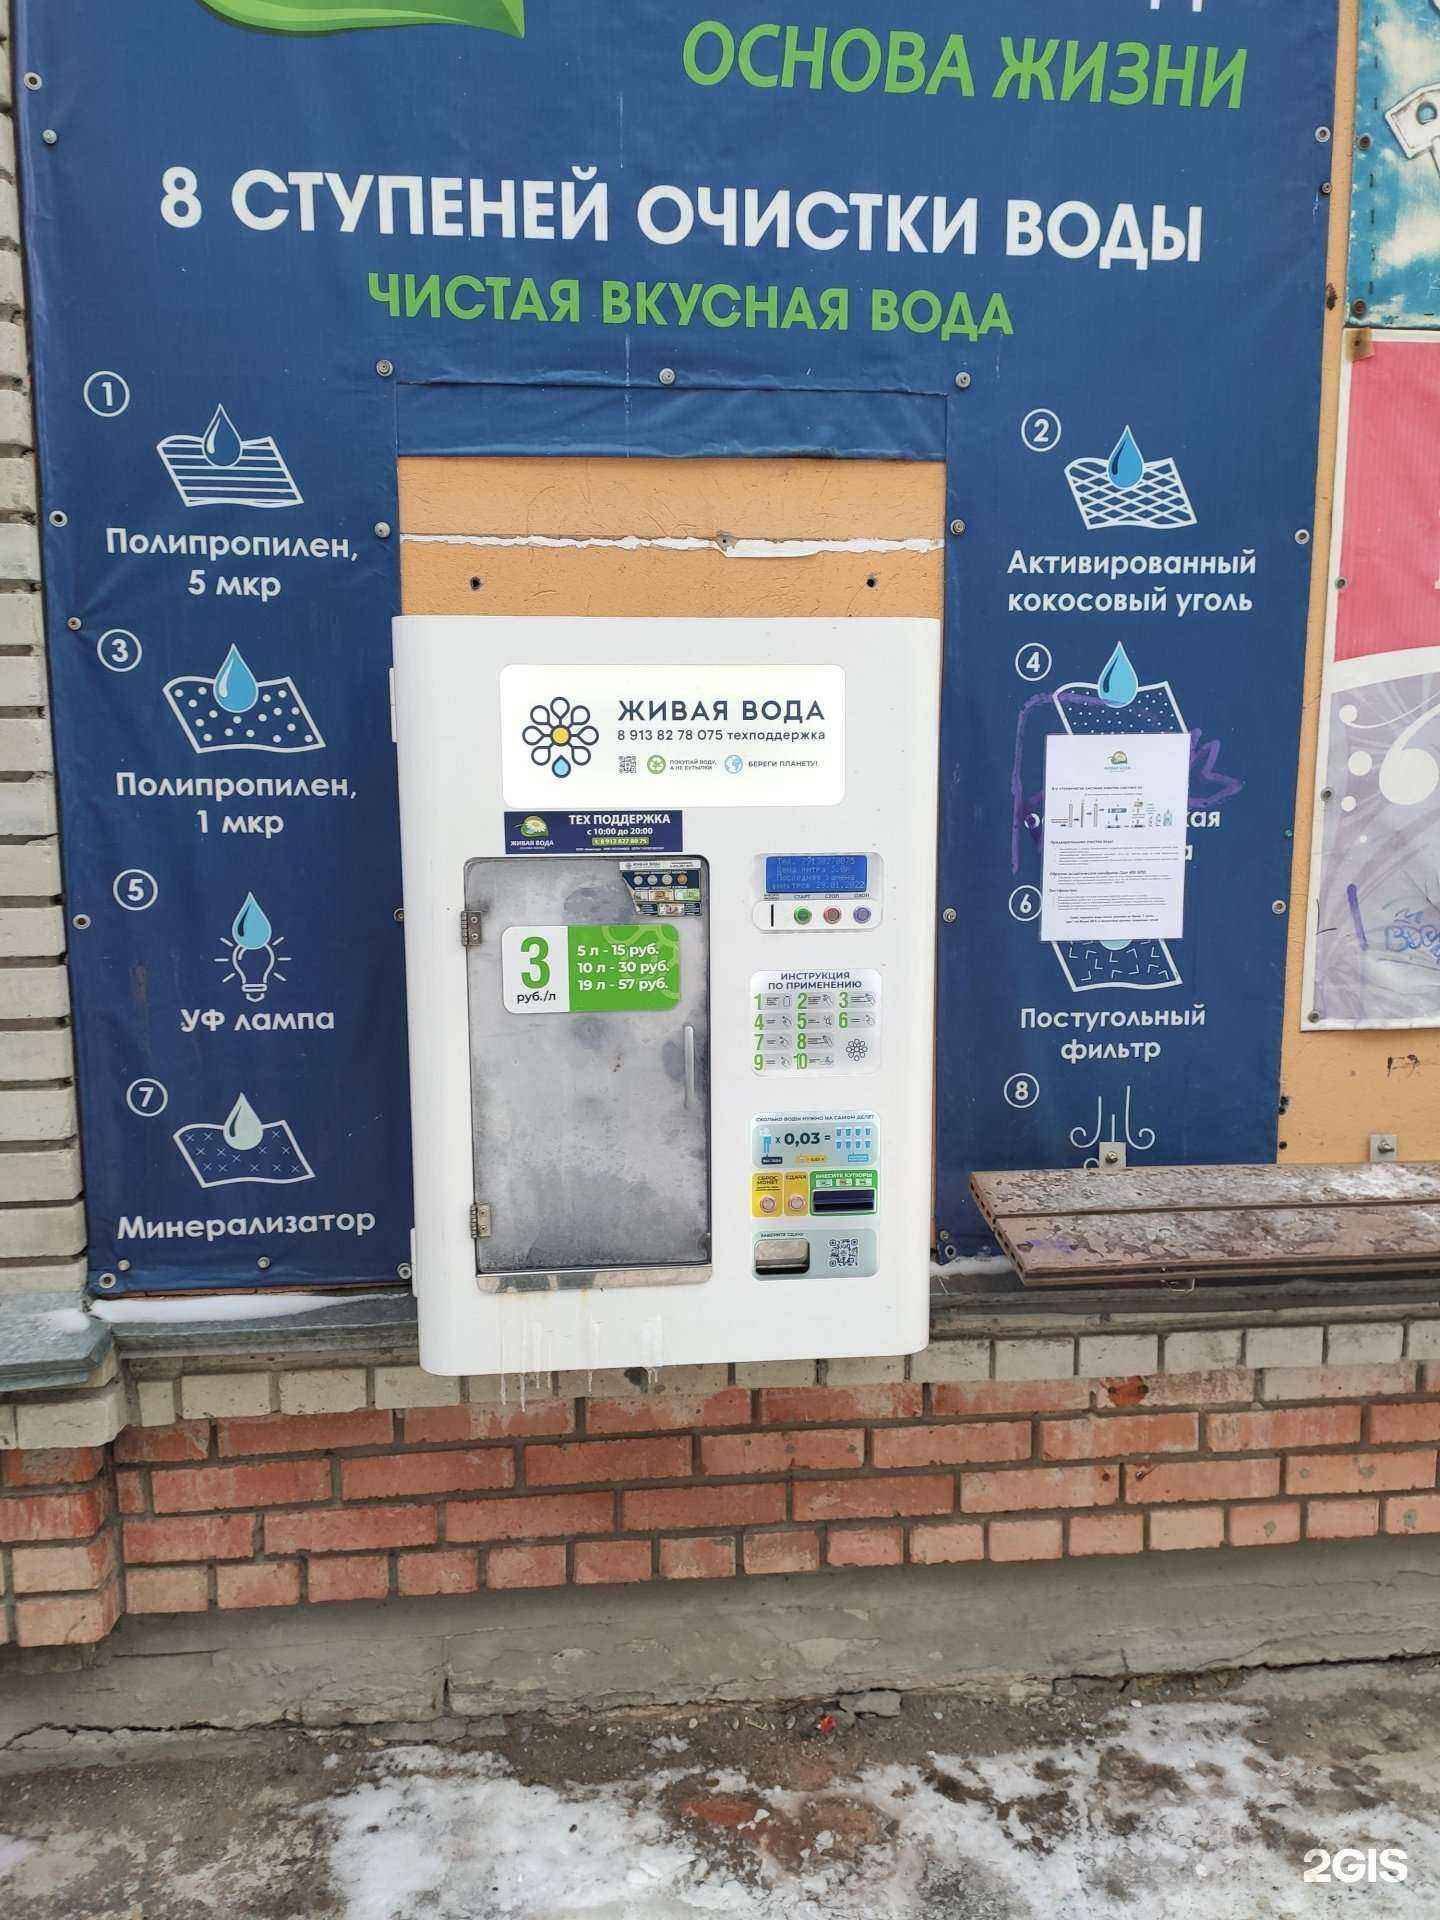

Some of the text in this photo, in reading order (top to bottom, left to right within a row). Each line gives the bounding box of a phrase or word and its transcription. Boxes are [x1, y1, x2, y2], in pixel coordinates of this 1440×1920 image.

[682, 20, 1247, 109] ОСНОВА ЖИЗНИ
[160, 165, 1203, 270] 8 СТУПЕНЕЙ ОЧИСТКИ ВОДЫ
[368, 272, 1014, 342] ЧИСТАЯ ВКУСНАЯ ВОДА
[101, 381, 113, 407] 1
[1033, 418, 1050, 443] 2
[106, 527, 358, 561] Полипропилен,
[1007, 548, 1256, 580] Активированный
[187, 569, 282, 602] 5 мкр
[1008, 586, 1253, 617] кокосовый уголь
[111, 638, 129, 663] 3
[1026, 651, 1041, 673] 4
[617, 699, 826, 724] ЖИВАЯ ВОДА
[617, 729, 826, 743] 8 913 82 78 075 техподдержка
[116, 771, 357, 802] Полипропилен,
[196, 809, 285, 839] 1 мкр
[569, 814, 671, 827] ТЕХ ПОДДЕРЖКА
[593, 827, 616, 836] 10:00
[617, 829, 628, 837] до
[630, 827, 653, 836] 20:00
[127, 878, 145, 901] 5
[1019, 893, 1032, 914] 6
[577, 945, 586, 957] 5
[589, 946, 599, 956] л
[611, 944, 626, 956] 15
[629, 943, 660, 958] руб.
[520, 936, 551, 989] 3
[577, 961, 593, 974] 10
[595, 963, 606, 973] л
[618, 961, 637, 973] 30
[640, 959, 670, 975] руб.
[577, 979, 593, 991] 19
[595, 980, 606, 991] л
[618, 978, 635, 990] 57
[638, 977, 669, 992] руб.
[768, 980, 863, 990] ПО ПРИМЕНЕНИЮ
[780, 971, 850, 980] ИНСТРУКЦИЯ
[517, 990, 556, 1004] руб./л
[754, 993, 762, 1010] 1
[797, 992, 808, 1010] 2
[838, 991, 848, 1009] 3
[179, 1008, 335, 1033] УФ лампа
[754, 1013, 764, 1030] 4
[797, 1012, 807, 1030] 5
[838, 1011, 848, 1028] 6
[1020, 1003, 1206, 1032] Постугольный
[754, 1033, 764, 1051] 7
[797, 1032, 807, 1050] 8
[1060, 1038, 1162, 1064] фильтр
[754, 1053, 764, 1071] 9
[793, 1052, 808, 1070] 10
[138, 1086, 155, 1108] 7
[1014, 1080, 1029, 1101] 8
[784, 1132, 820, 1148] 0,03
[117, 1211, 376, 1241] Минерализатор
